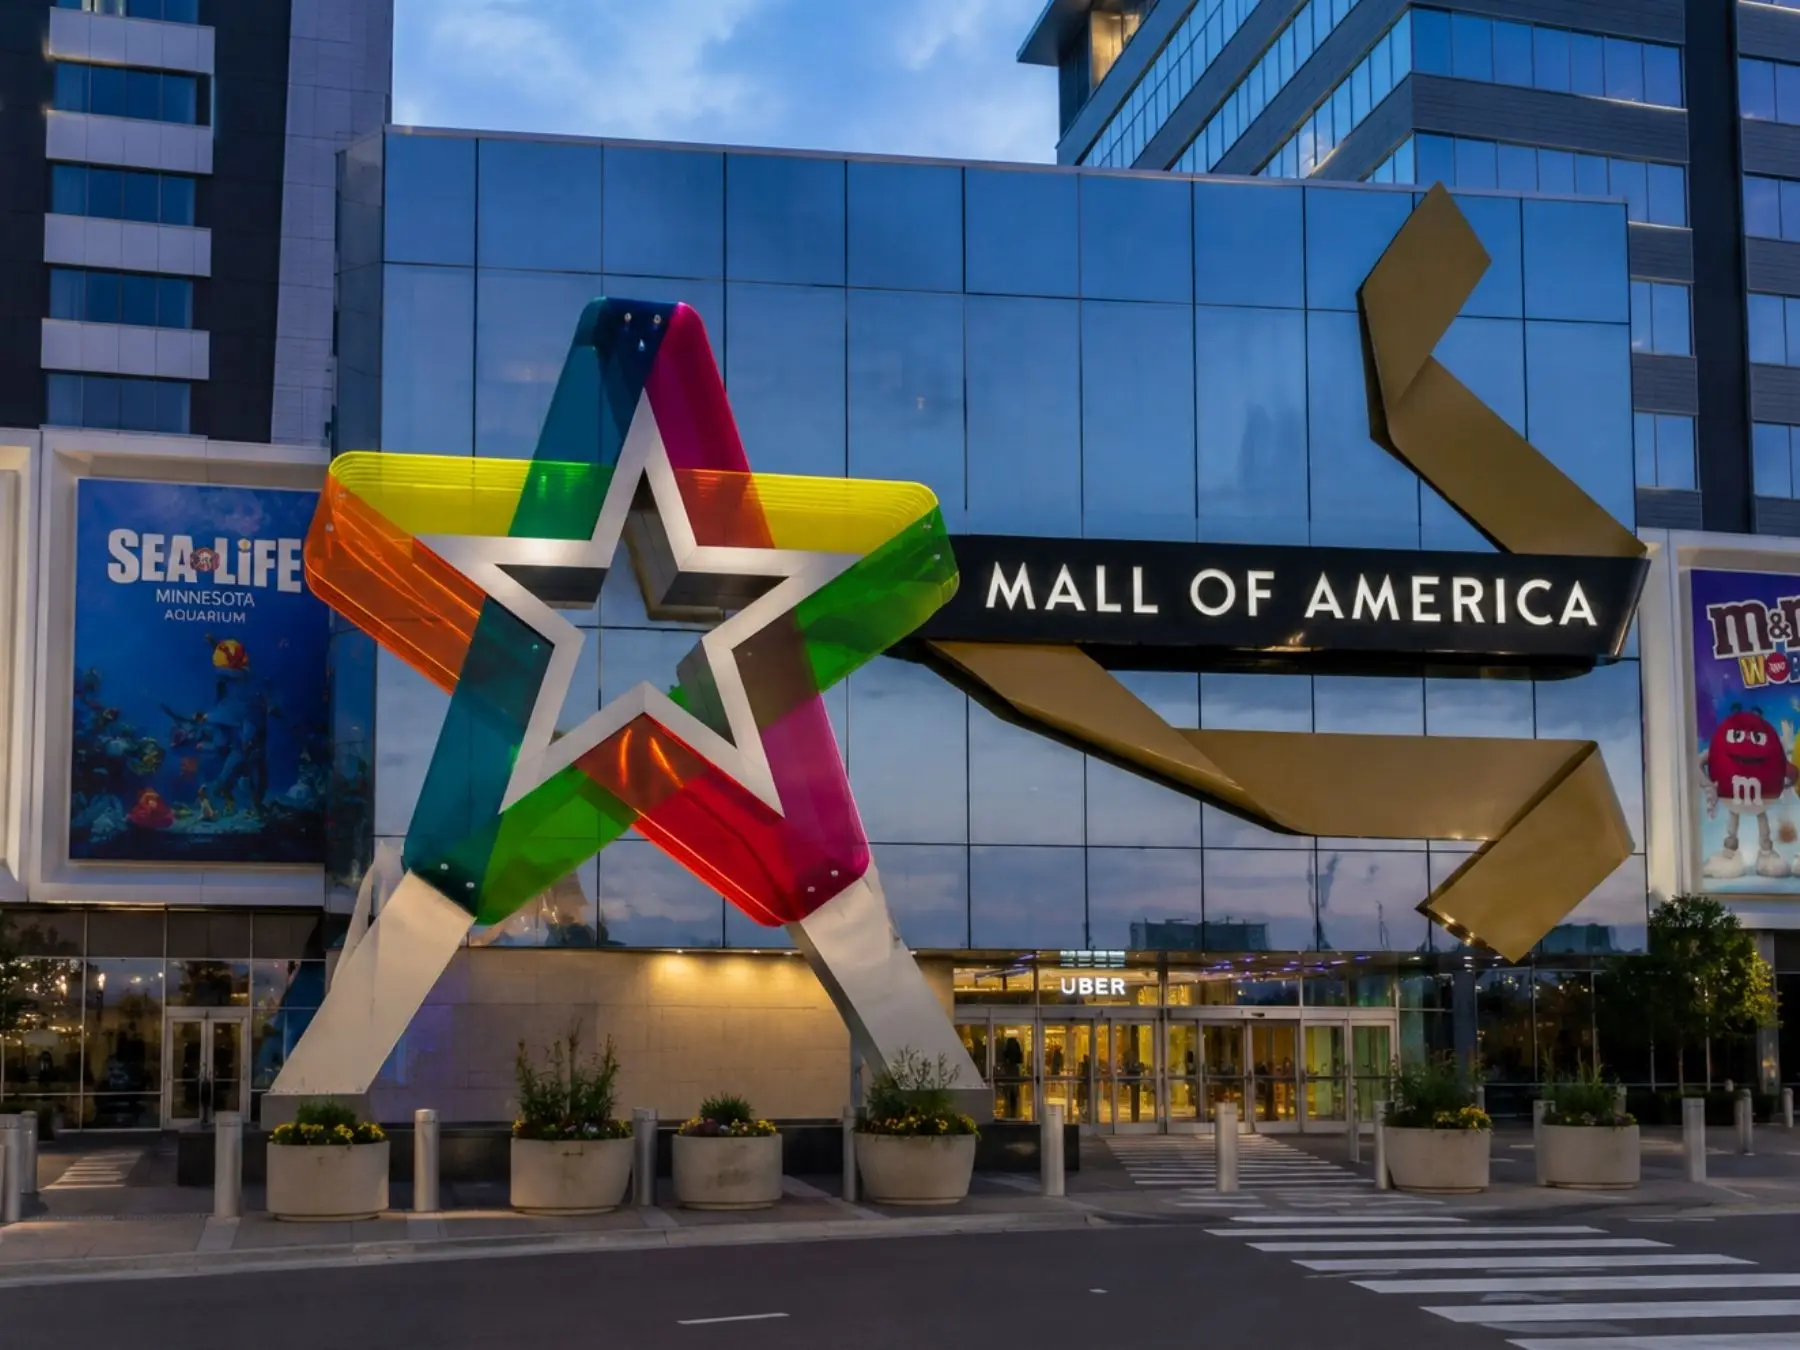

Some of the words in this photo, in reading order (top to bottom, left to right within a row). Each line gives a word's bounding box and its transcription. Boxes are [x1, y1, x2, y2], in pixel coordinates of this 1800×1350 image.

[107, 528, 198, 584] SEA
[156, 588, 256, 608] MINNESOTA
[985, 561, 1159, 614] MALL
[1189, 568, 1275, 617] OF
[1304, 571, 1598, 627] AMERICA
[164, 609, 246, 624] AQUARIUM
[1731, 774, 1763, 806] m
[1060, 976, 1126, 995] UBER
